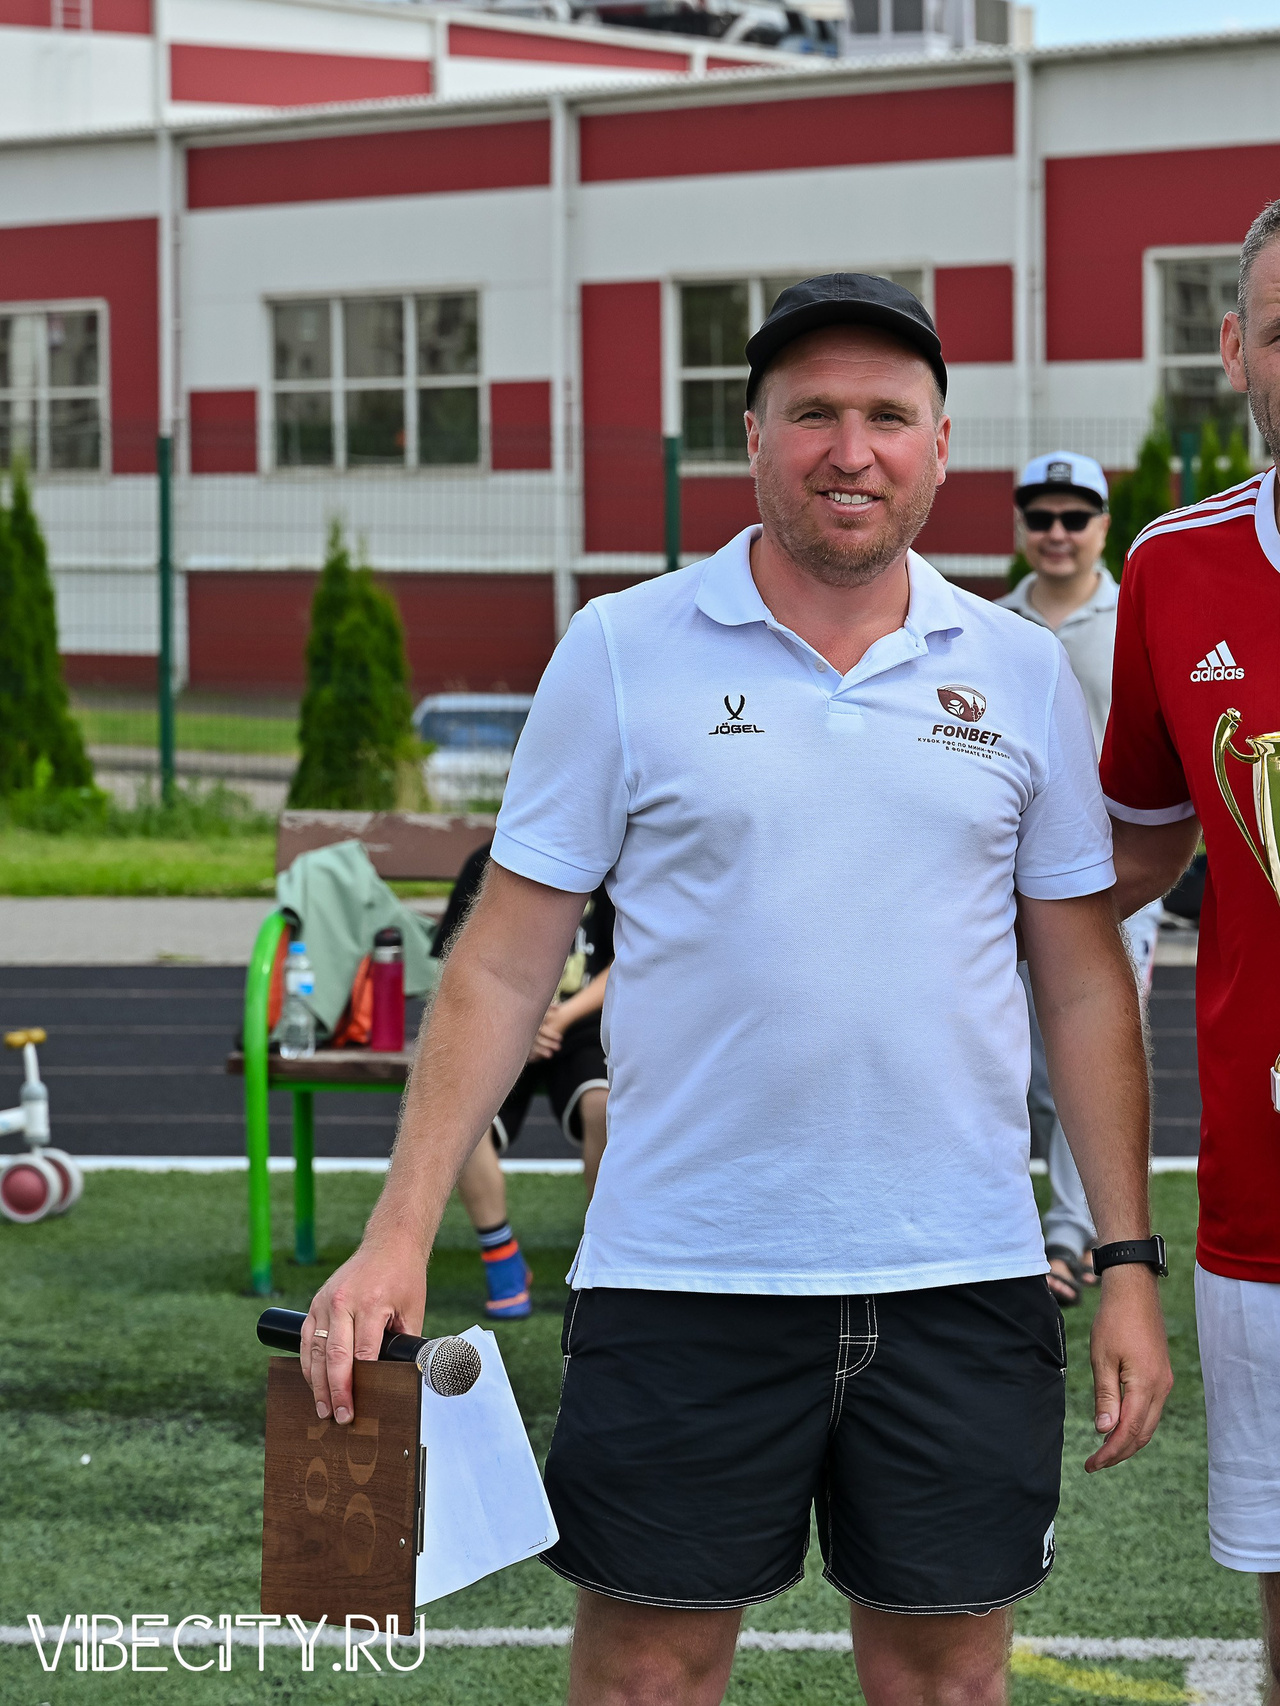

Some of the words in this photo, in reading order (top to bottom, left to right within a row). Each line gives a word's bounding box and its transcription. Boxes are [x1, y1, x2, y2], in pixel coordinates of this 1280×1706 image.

[1190, 666, 1245, 682] adidas
[708, 722, 765, 735] JÖGEL
[932, 724, 1002, 747] FONBET
[951, 747, 980, 757] ФОРМАТЕ
